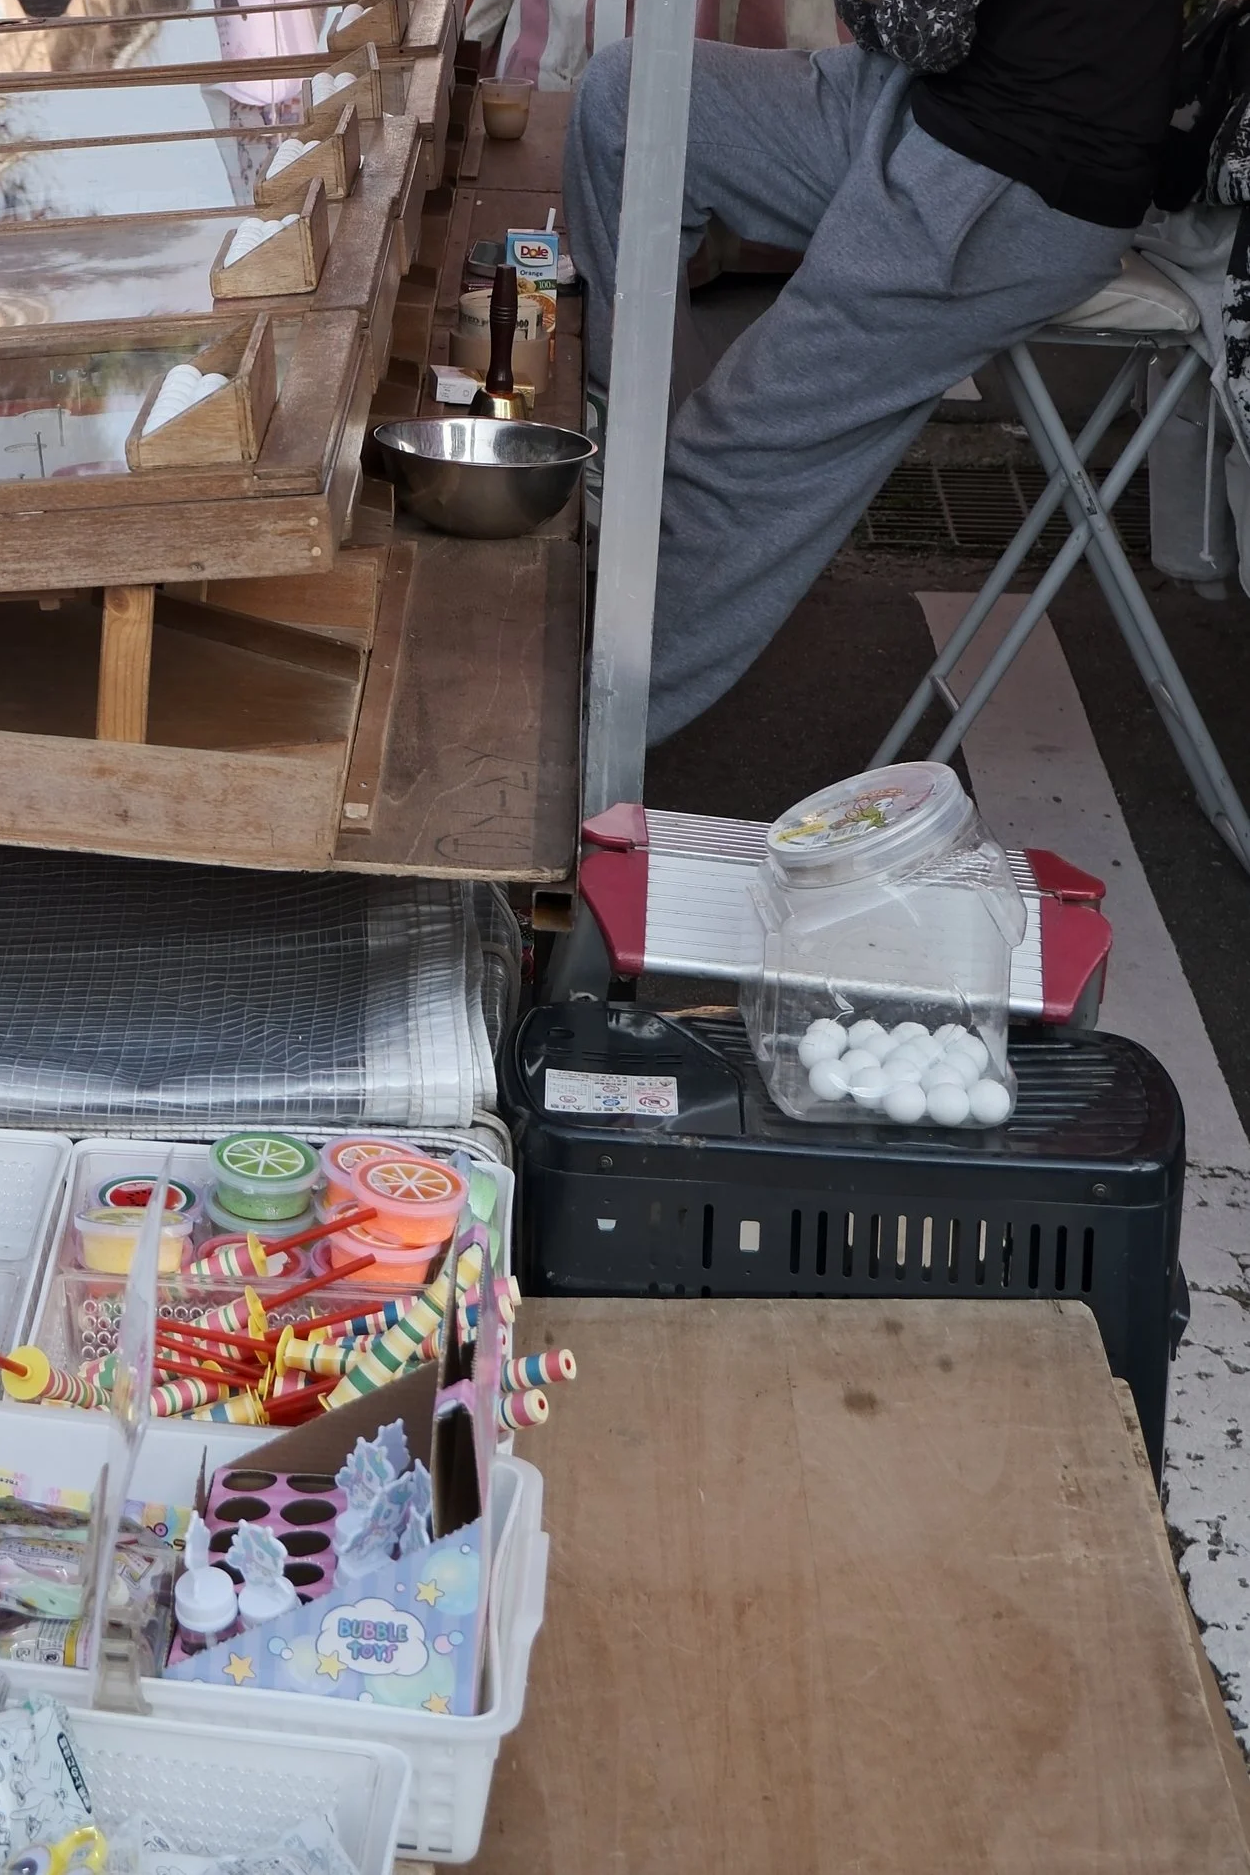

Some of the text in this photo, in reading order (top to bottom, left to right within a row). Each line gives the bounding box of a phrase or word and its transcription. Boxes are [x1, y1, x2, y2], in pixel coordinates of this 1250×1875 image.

[521, 245, 549, 258] Dole
[520, 269, 543, 277] Orange
[336, 1615, 410, 1644] BUBBLE
[345, 1641, 399, 1664] TOYS
